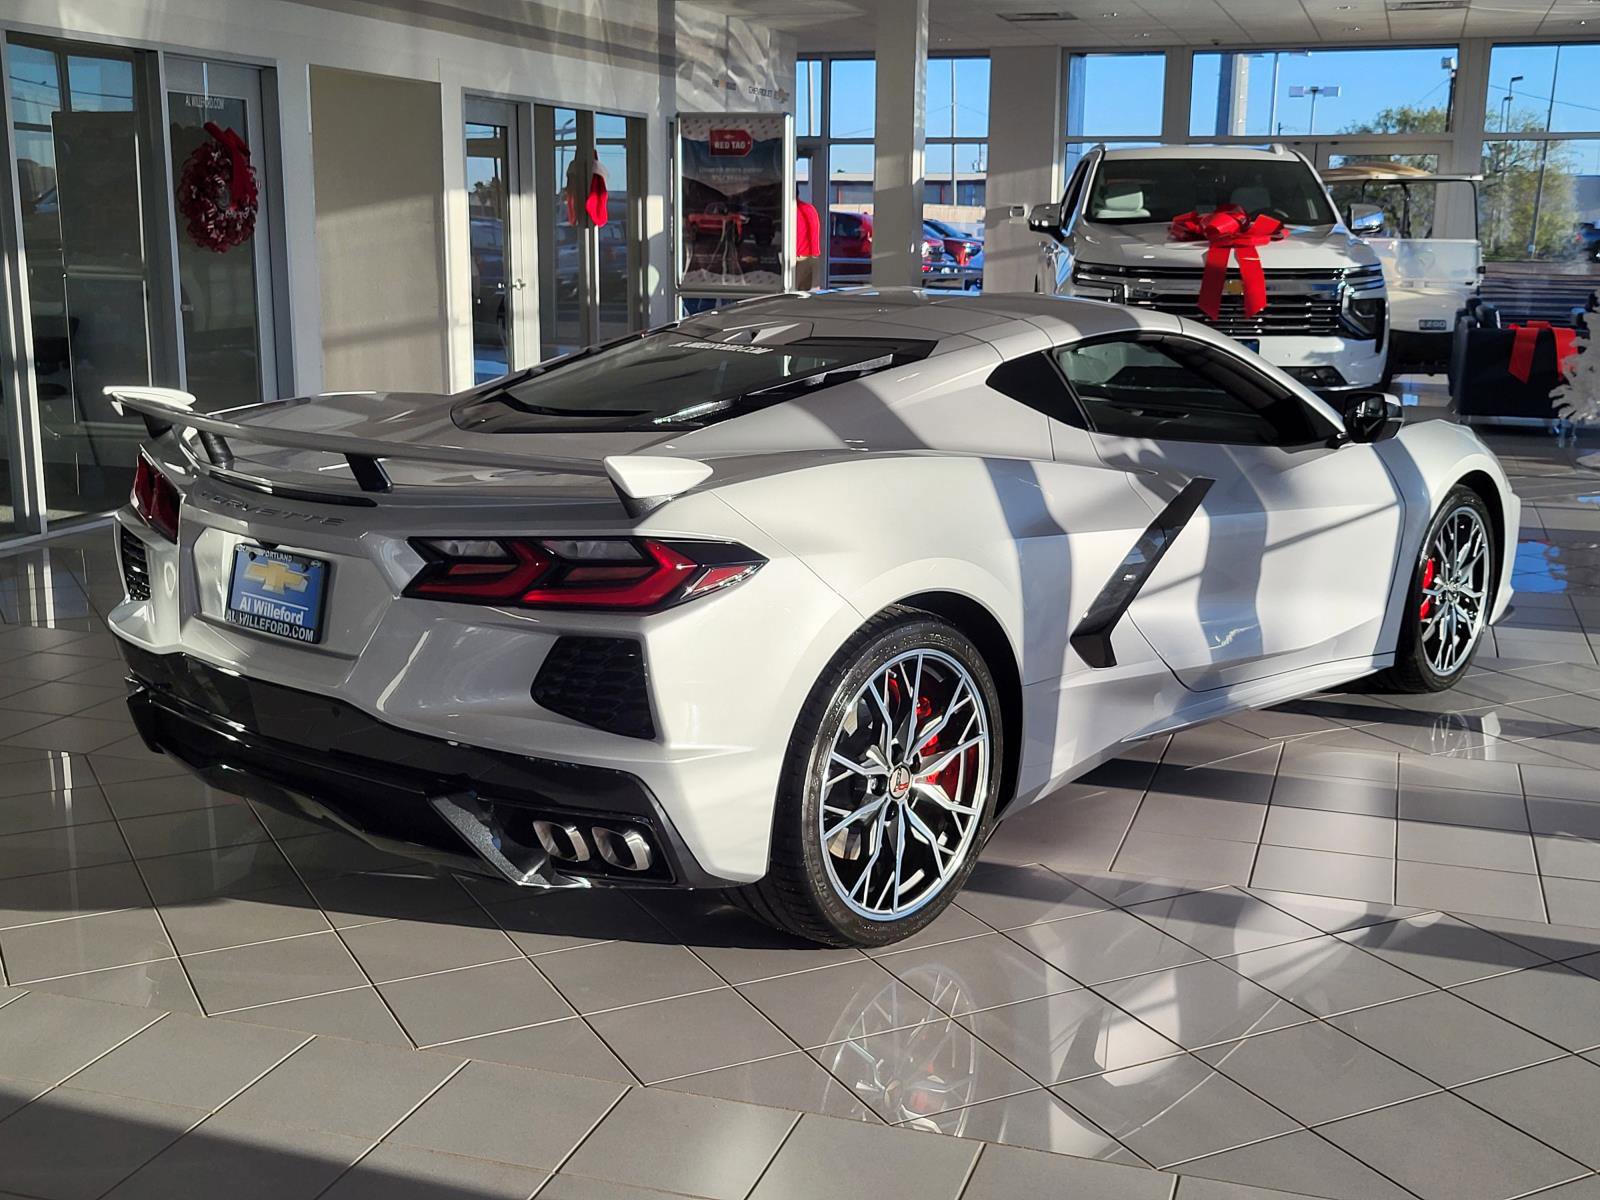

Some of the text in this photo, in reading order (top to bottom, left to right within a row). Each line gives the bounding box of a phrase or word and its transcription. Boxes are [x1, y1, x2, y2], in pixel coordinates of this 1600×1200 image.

[714, 141, 746, 149] RED TAG
[260, 549, 293, 562] PORTLAND
[240, 596, 304, 625] Al Willeford
[226, 610, 314, 642] AL WILLEFORD.COM
